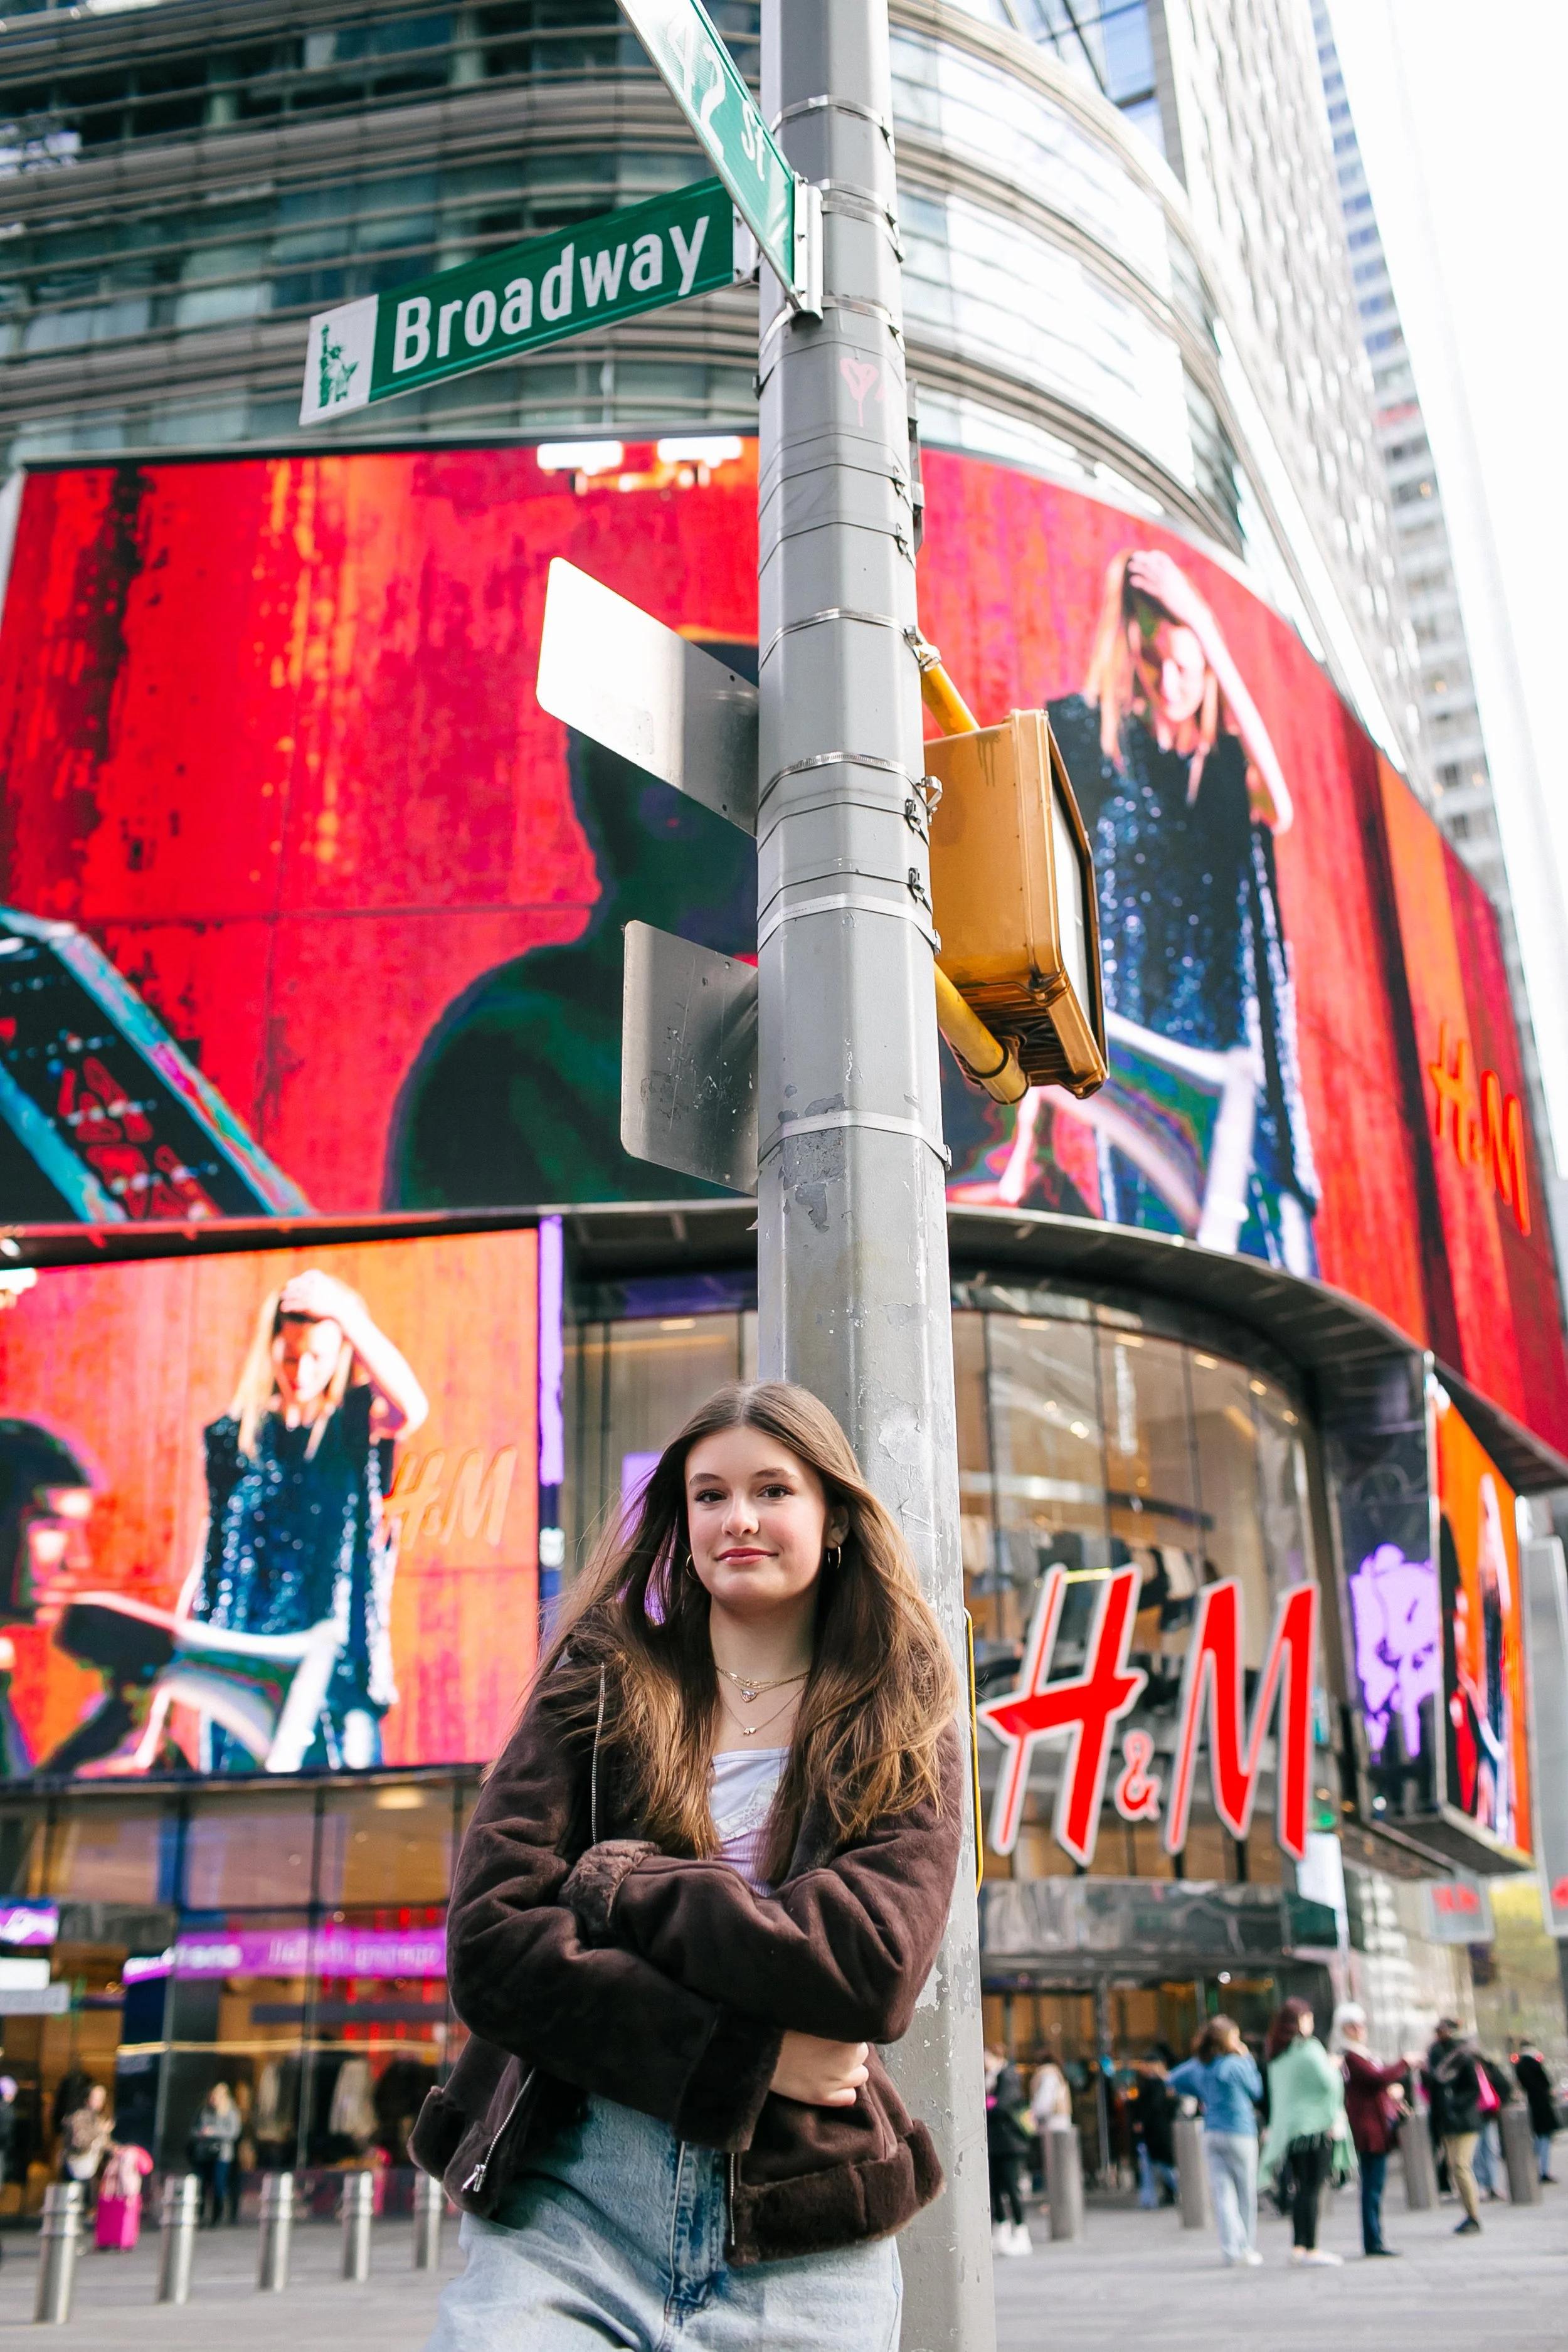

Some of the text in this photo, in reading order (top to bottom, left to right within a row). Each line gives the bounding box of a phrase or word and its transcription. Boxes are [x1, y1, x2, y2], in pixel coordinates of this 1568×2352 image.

[666, 9, 765, 181] 42 St
[393, 215, 709, 373] Broadway
[977, 1564, 1318, 1866] H&M
